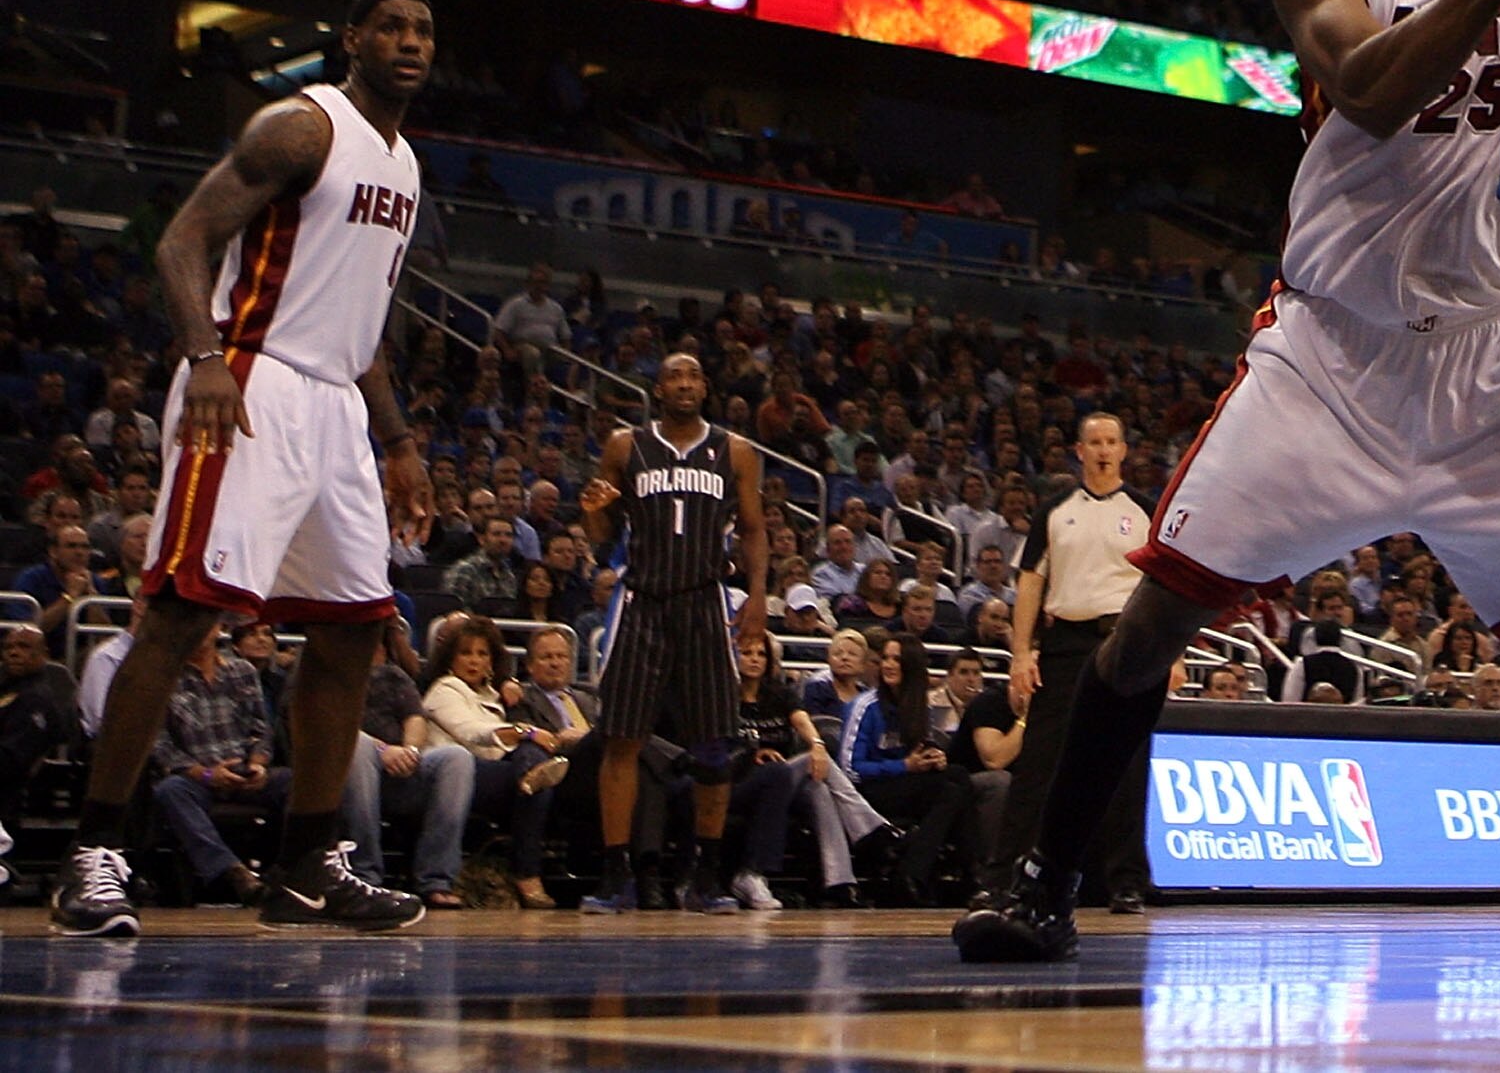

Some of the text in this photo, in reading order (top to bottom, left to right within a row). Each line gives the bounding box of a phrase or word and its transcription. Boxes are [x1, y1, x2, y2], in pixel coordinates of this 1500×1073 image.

[636, 467, 724, 499] ORLANDO
[674, 497, 684, 535] 1
[1151, 758, 1329, 826] BBVA
[1165, 829, 1338, 861] Official Bank
